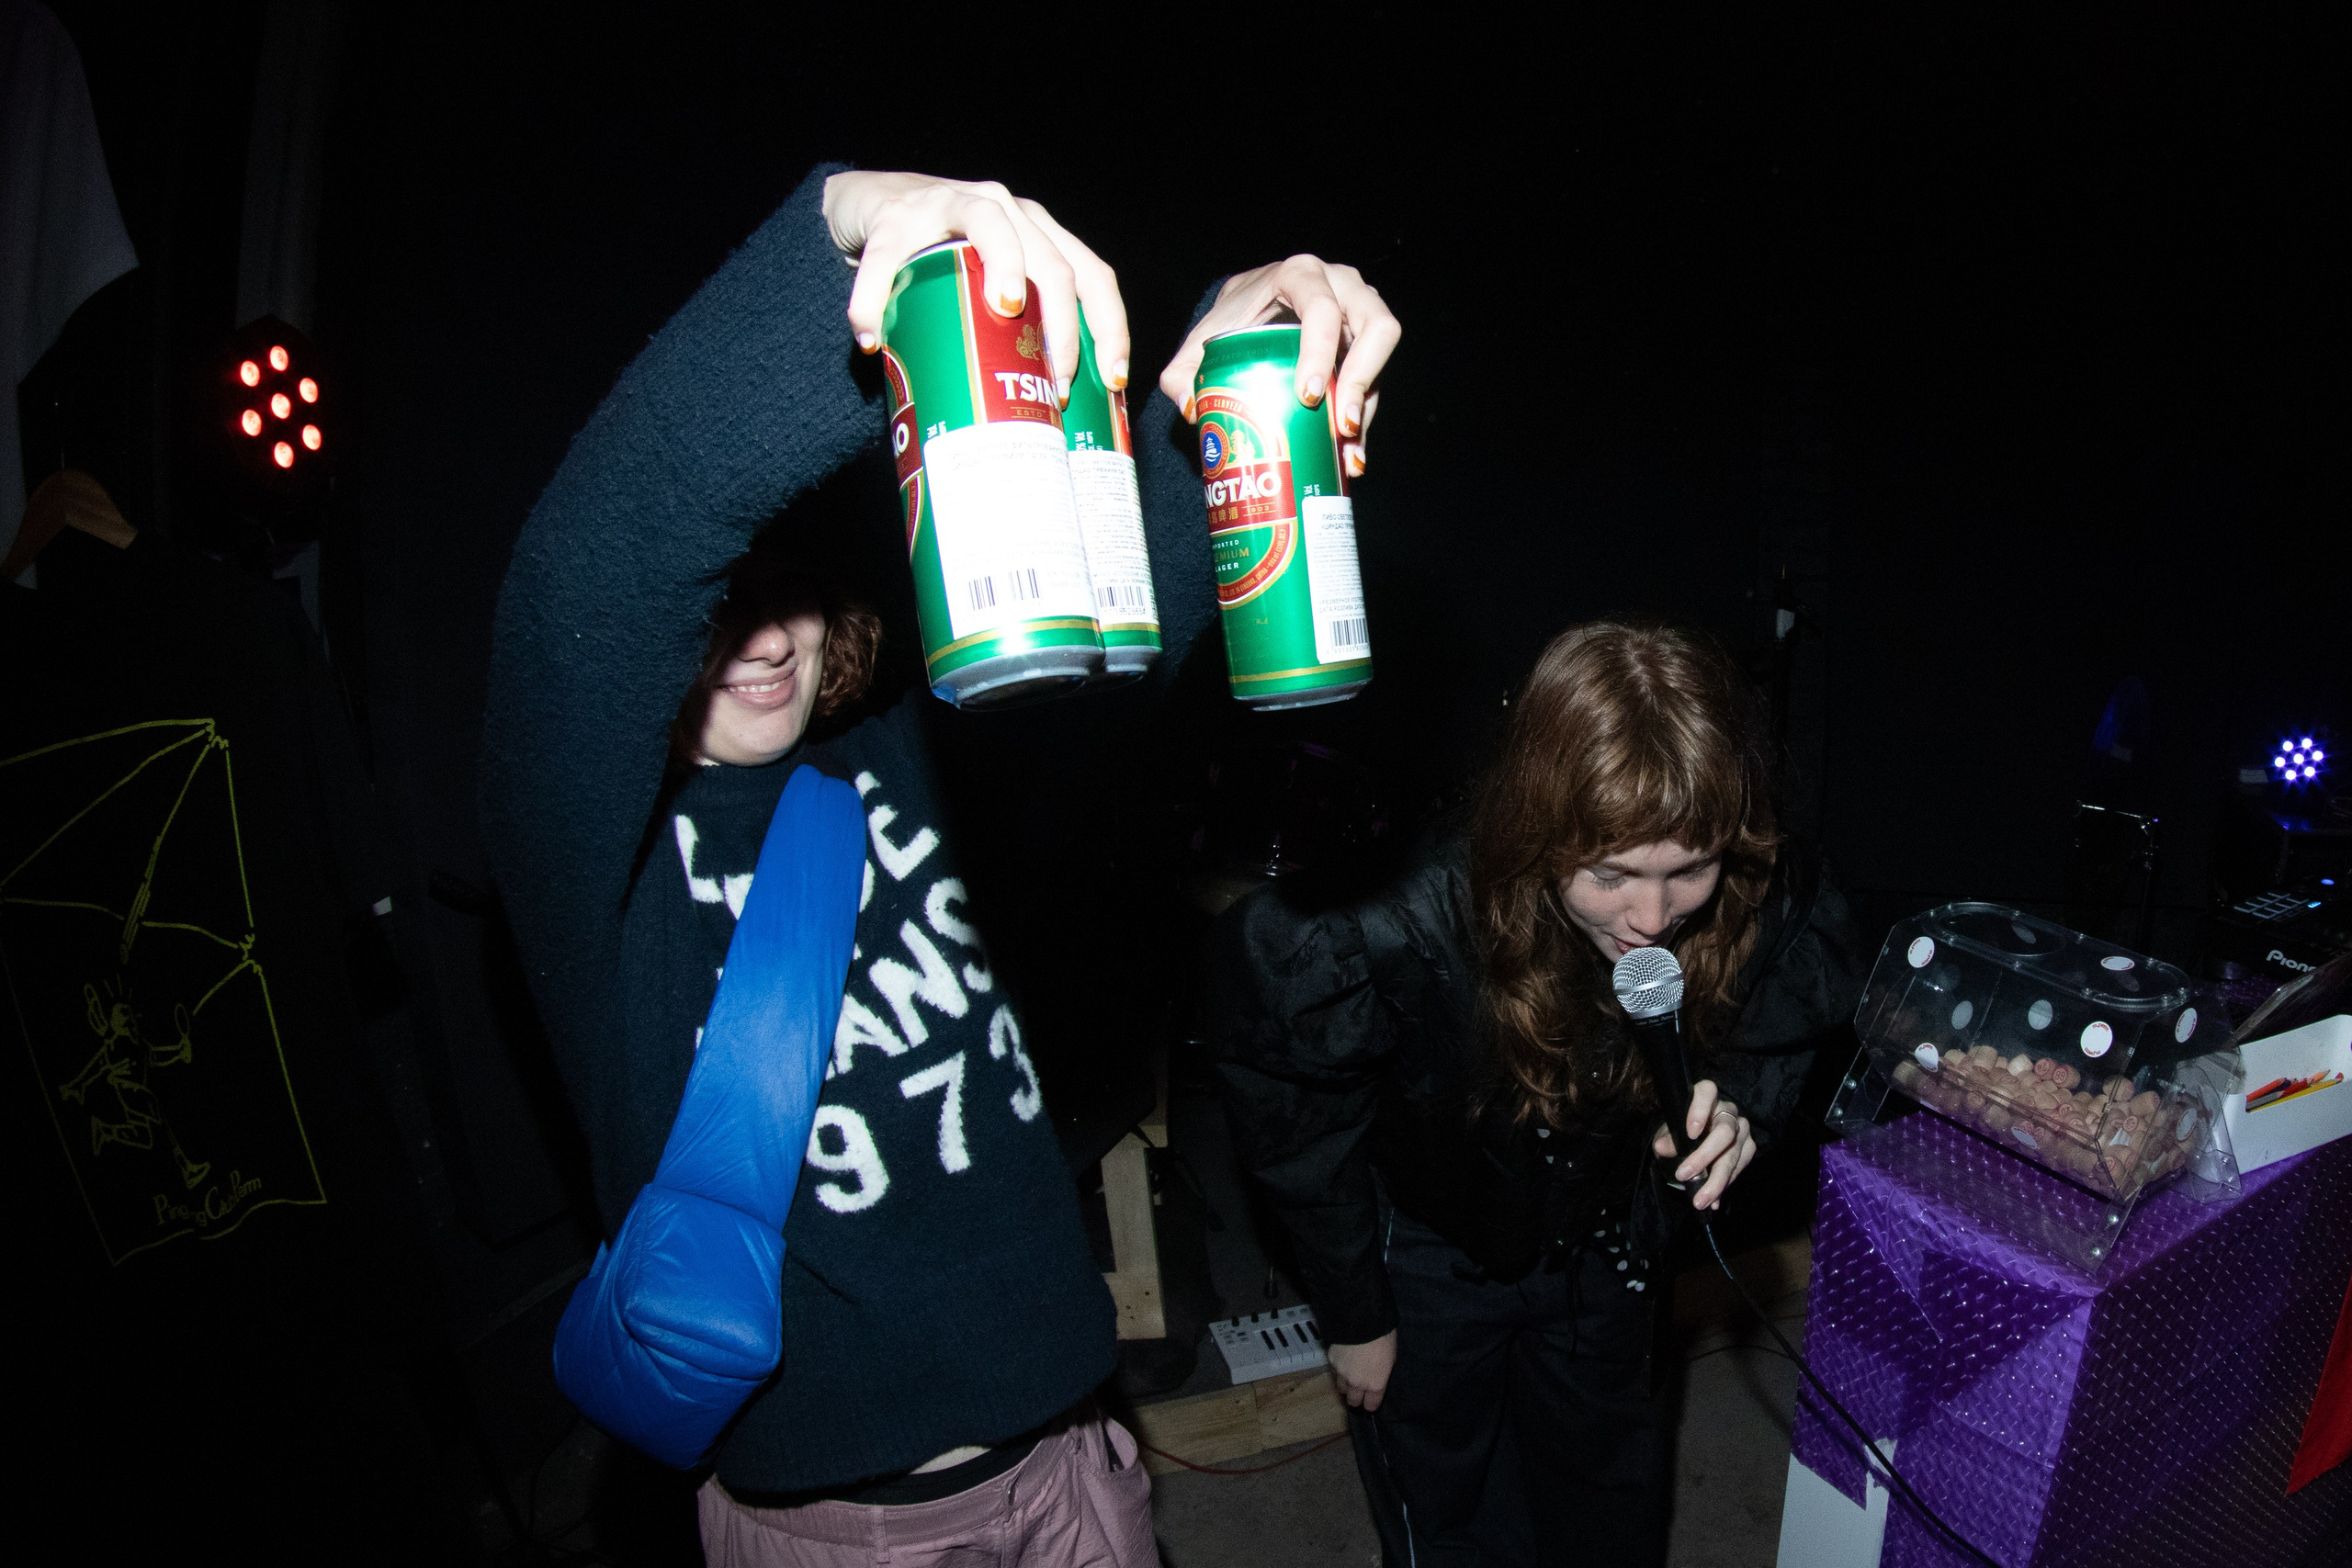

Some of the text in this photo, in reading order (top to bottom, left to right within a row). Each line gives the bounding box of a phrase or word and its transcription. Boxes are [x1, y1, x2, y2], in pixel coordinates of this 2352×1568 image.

[994, 372, 1059, 409] TSIN
[1016, 409, 1043, 417] ESTD
[1247, 505, 1270, 514] 1903
[1215, 562, 1239, 573] LAGER
[807, 1004, 1041, 1213] 973
